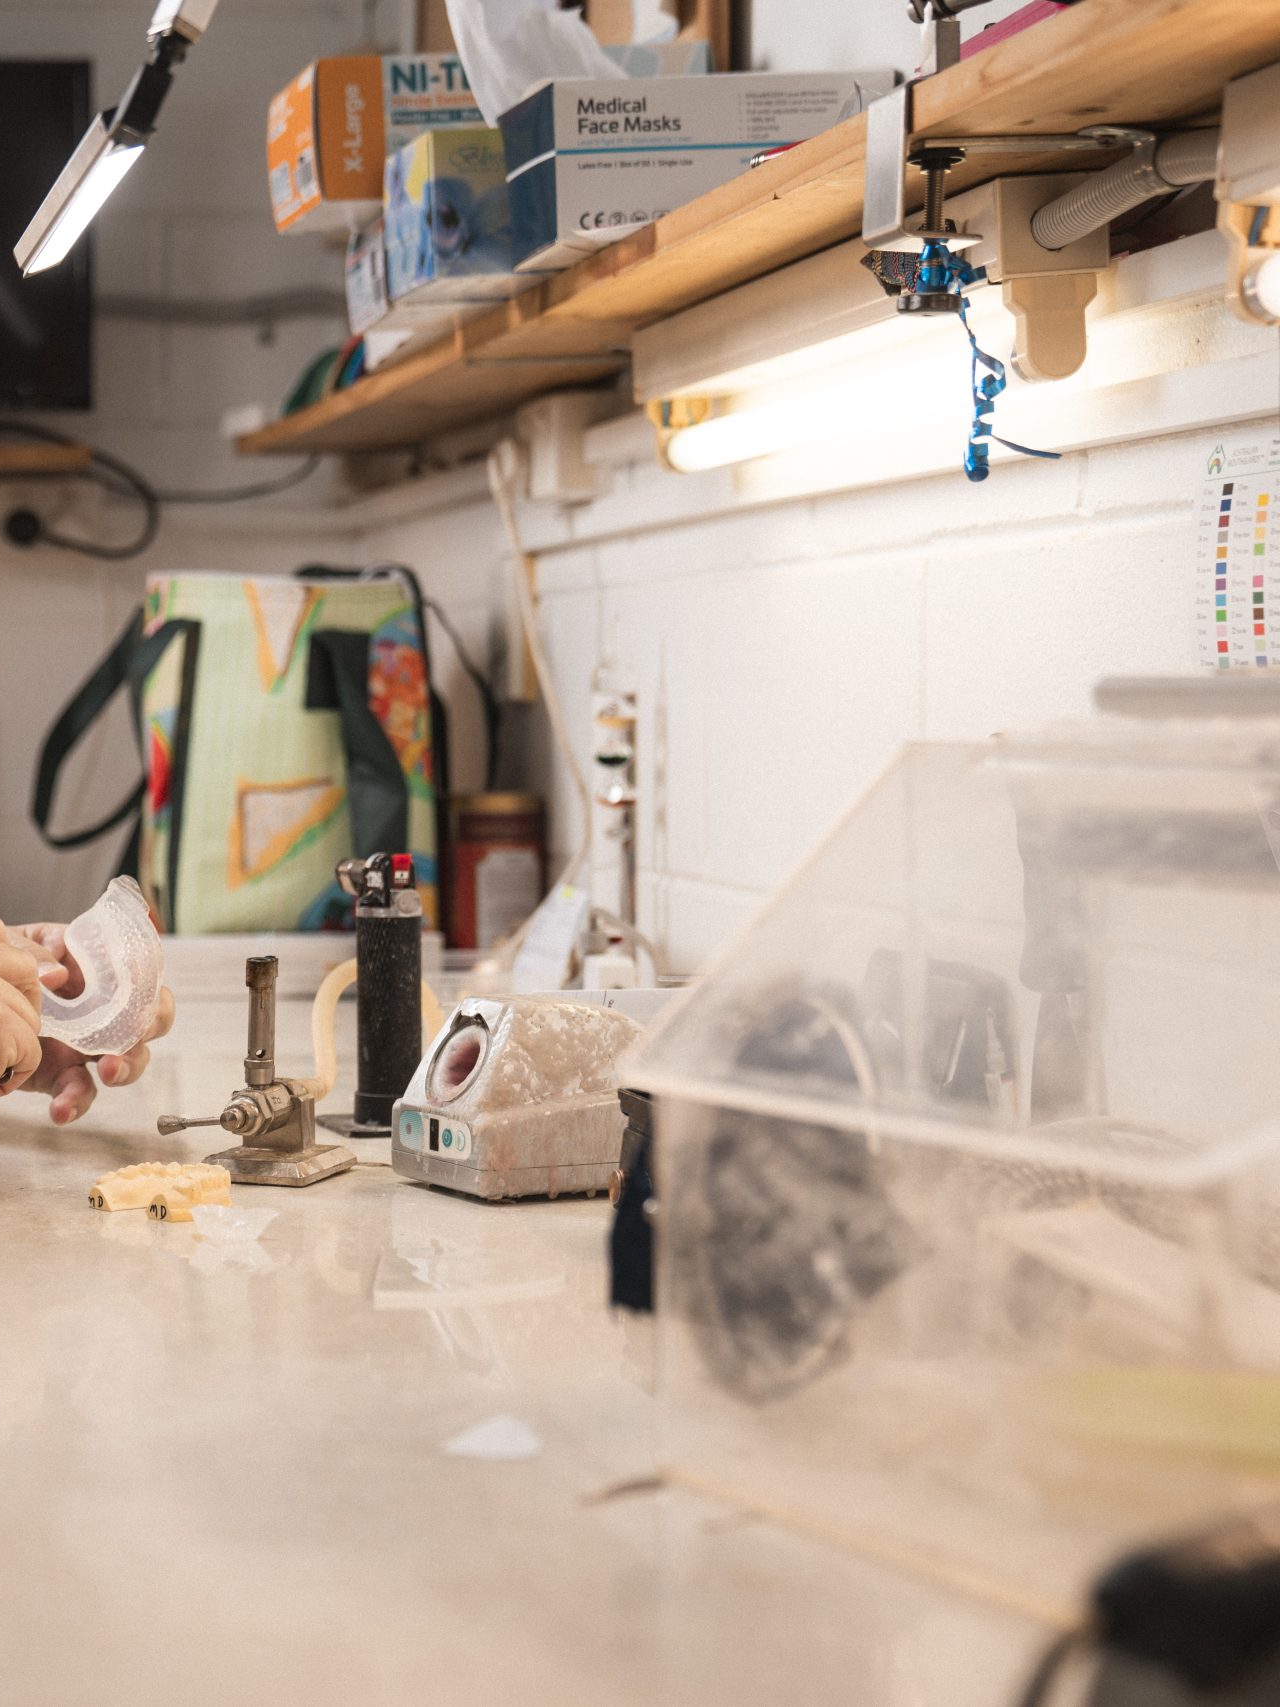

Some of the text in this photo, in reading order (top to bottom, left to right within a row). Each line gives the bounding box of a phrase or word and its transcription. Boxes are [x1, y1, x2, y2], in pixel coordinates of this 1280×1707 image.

[577, 97, 647, 115] Medical
[342, 84, 365, 173] X-Large
[578, 115, 681, 134] Face Masks
